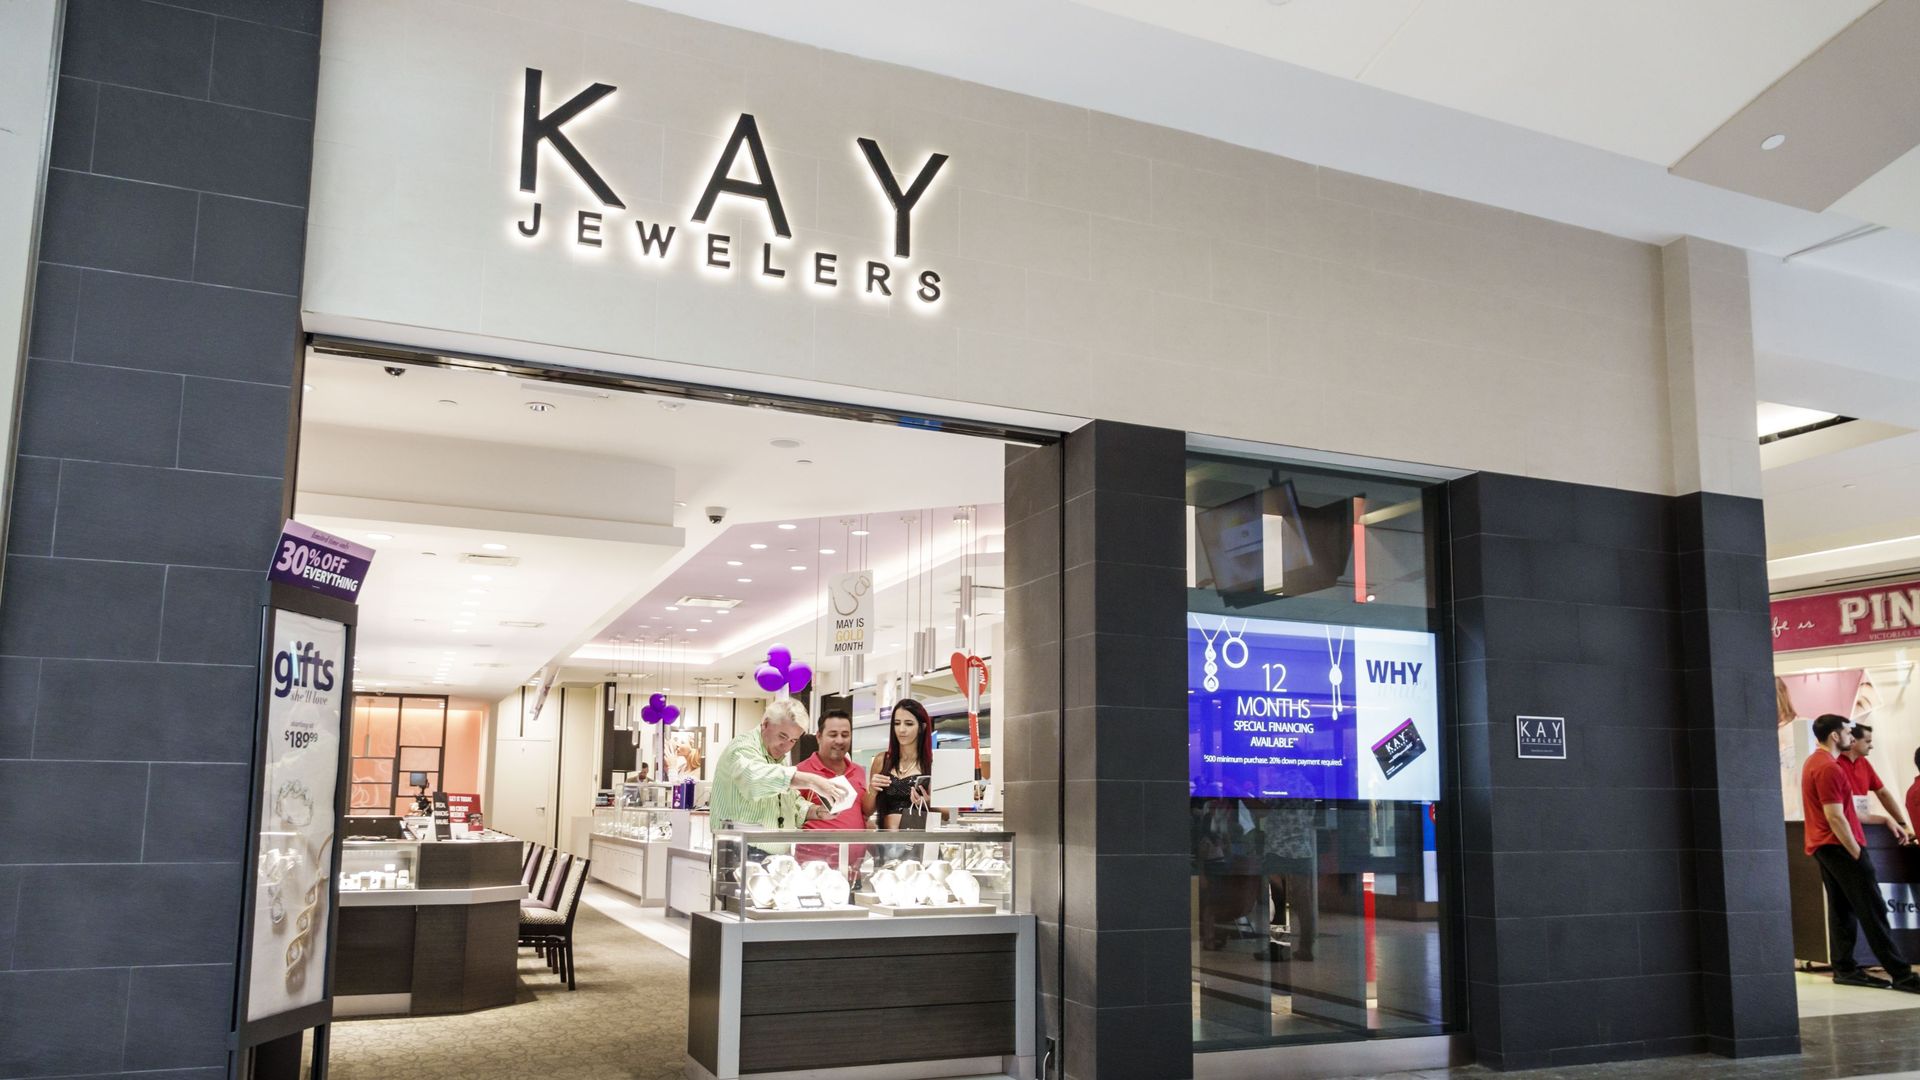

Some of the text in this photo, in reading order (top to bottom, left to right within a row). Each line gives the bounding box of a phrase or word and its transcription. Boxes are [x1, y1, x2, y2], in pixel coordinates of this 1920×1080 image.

[519, 67, 949, 258] KAY
[517, 203, 942, 302] JEWELERS
[276, 540, 321, 575] 30%
[303, 566, 358, 592] EVERYTHING
[836, 617, 864, 629] MAY IS
[1798, 620, 1815, 630] is
[1839, 589, 1920, 634] PIN
[834, 641, 864, 652] MONTH
[836, 629, 864, 642] GOLD
[274, 641, 334, 698] gifts
[1262, 663, 1287, 692] 12
[1366, 659, 1423, 685] WHY
[1236, 696, 1311, 719] MONTHS
[1234, 720, 1314, 734] SPECIAL FINANCING
[1520, 721, 1560, 738] KAY
[1217, 755, 1243, 763] minimum
[1244, 756, 1268, 765] purchase.
[1269, 756, 1281, 764] 20%
[1282, 756, 1297, 765] down
[1297, 758, 1321, 766] payment
